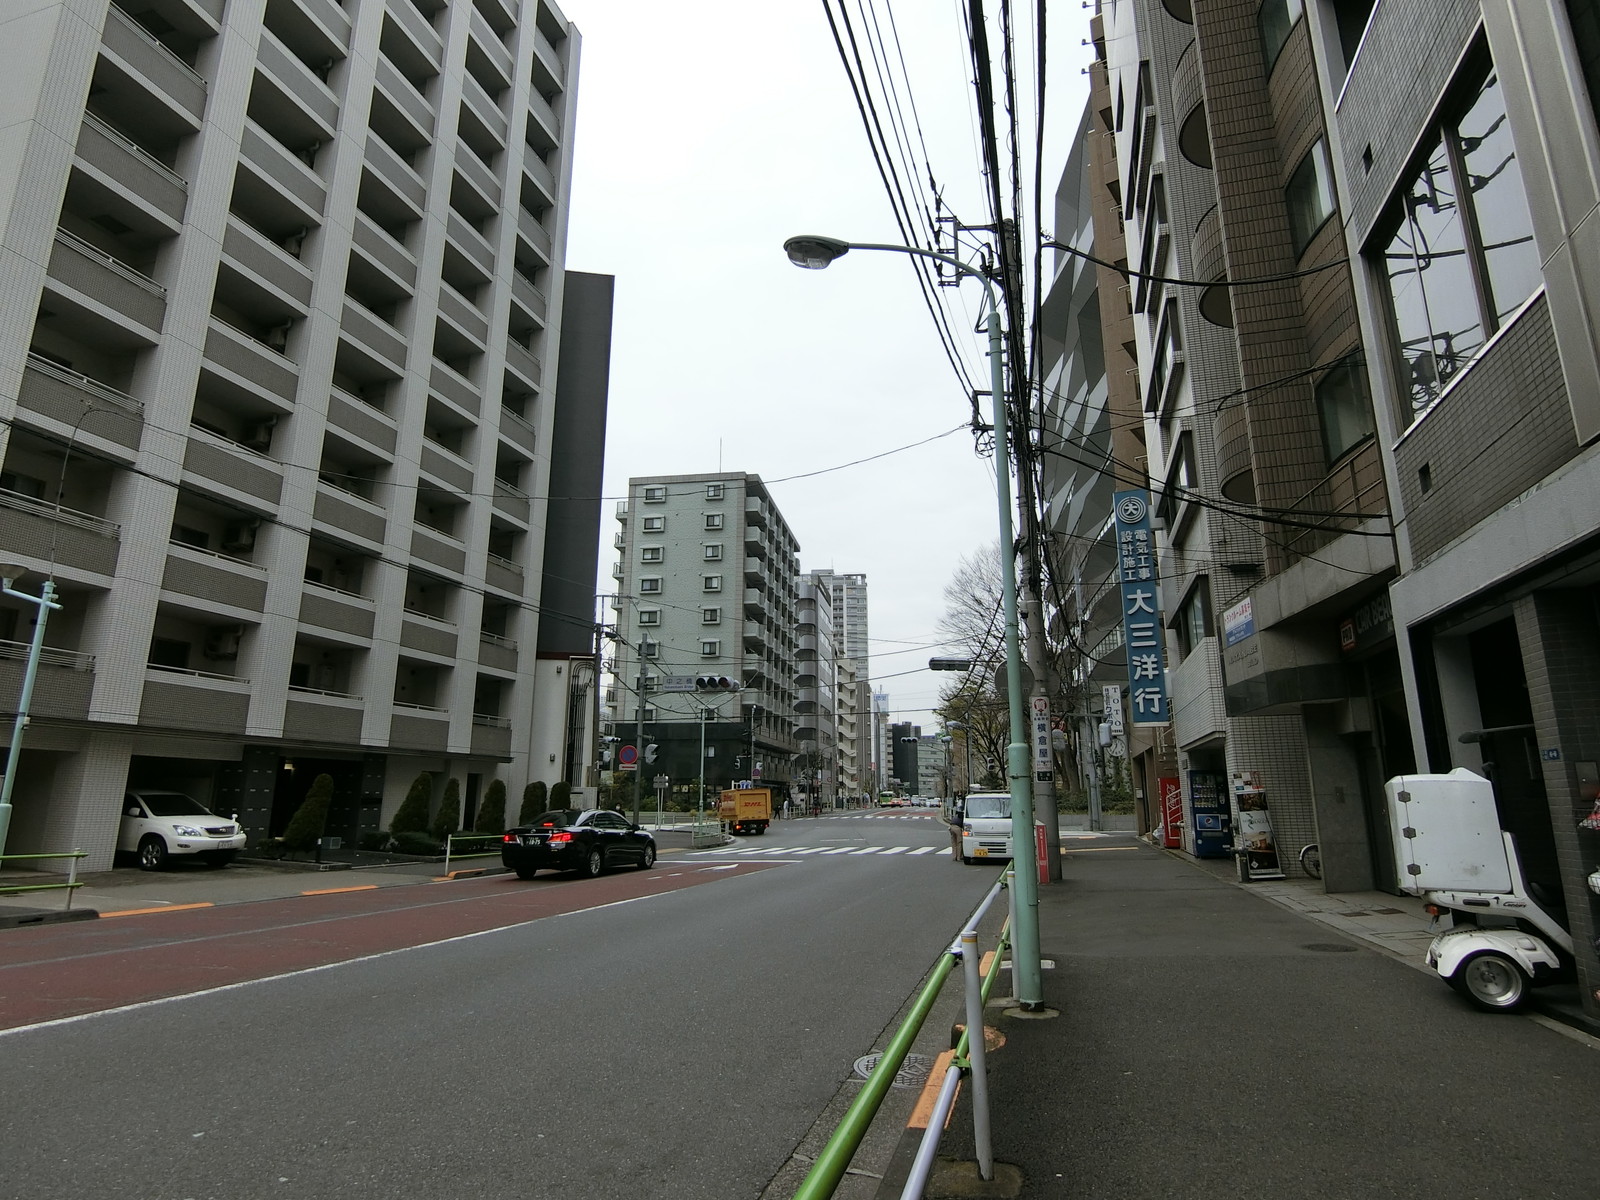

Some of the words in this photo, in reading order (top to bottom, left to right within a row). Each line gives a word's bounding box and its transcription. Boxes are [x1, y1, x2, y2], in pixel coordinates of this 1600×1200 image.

[1120, 530, 1137, 581] 設計施工
[1134, 528, 1151, 580] 電気工事
[1126, 589, 1162, 714] 大三洋行
[666, 677, 693, 685] 中之橋
[1111, 687, 1122, 727] TOTO
[1037, 722, 1049, 758] 横倉屋
